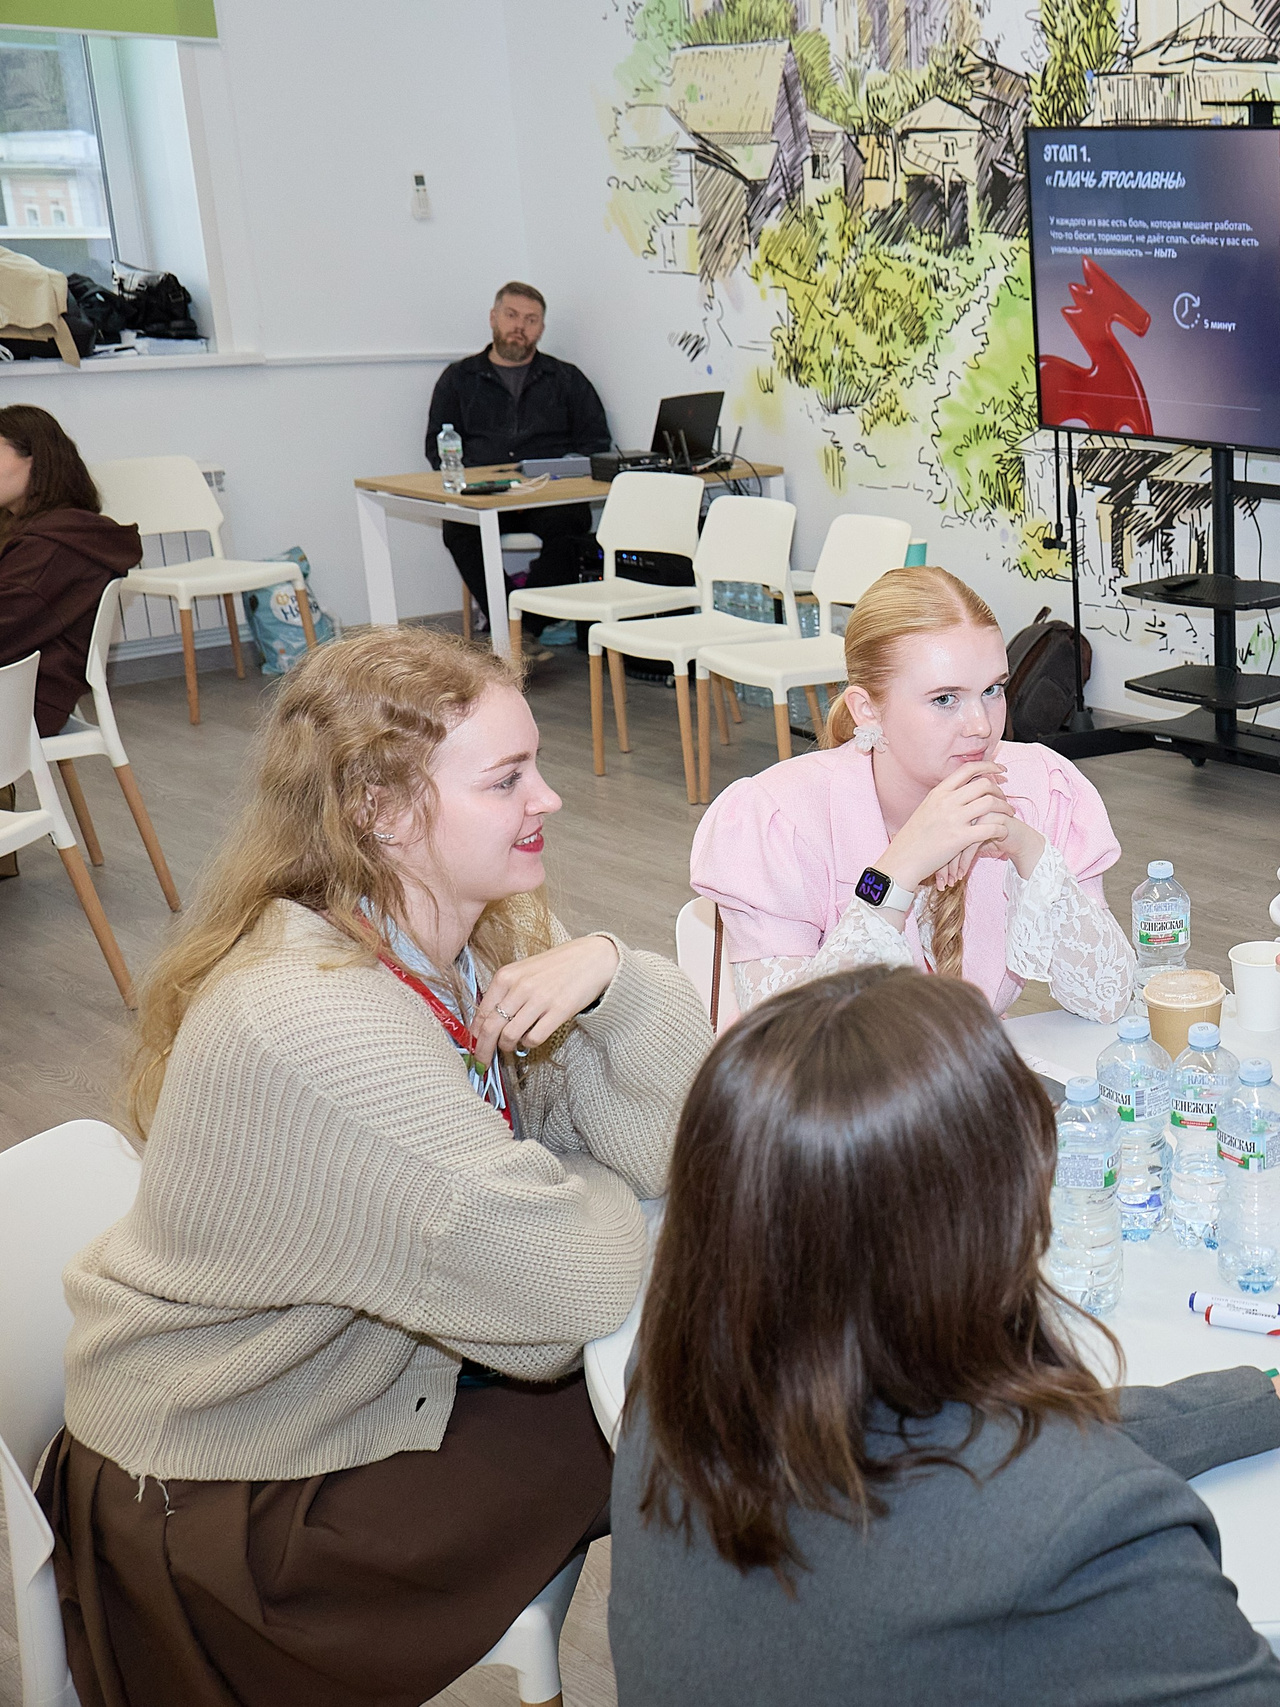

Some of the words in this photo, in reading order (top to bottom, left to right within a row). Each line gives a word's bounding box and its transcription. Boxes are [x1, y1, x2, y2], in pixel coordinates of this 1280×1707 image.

[1043, 144, 1078, 162] ЭТАП
[1080, 145, 1091, 162] 1.
[1045, 170, 1097, 188] «ПЛАЧЬ
[1098, 170, 1186, 189] ЯРОСЛАВНЫ»
[1049, 216, 1055, 225] У
[1056, 217, 1086, 228] каждого
[1087, 218, 1096, 226] из
[1097, 219, 1110, 227] вас
[1111, 219, 1127, 228] есть
[1128, 217, 1149, 229] боль,
[1150, 220, 1181, 230] которая
[1182, 221, 1213, 230] мешает
[1214, 219, 1253, 232] работать.
[1050, 230, 1073, 240] Что-то
[1074, 230, 1096, 242] бесит,
[1098, 233, 1134, 244] тормозит,
[1136, 234, 1145, 242] не
[1146, 233, 1164, 244] даёт
[1166, 235, 1189, 245] спать.
[1191, 234, 1218, 245] Сейчас
[1219, 237, 1225, 247] у
[1226, 237, 1240, 246] вас
[1241, 238, 1259, 247] есть
[1050, 246, 1093, 255] уникальная
[1094, 247, 1144, 257] возможность
[1154, 247, 1178, 258] НЫТЬ
[1203, 319, 1209, 329] 5
[1210, 321, 1236, 332] минут
[1140, 919, 1184, 932] СЕНЕЖСКАЯ
